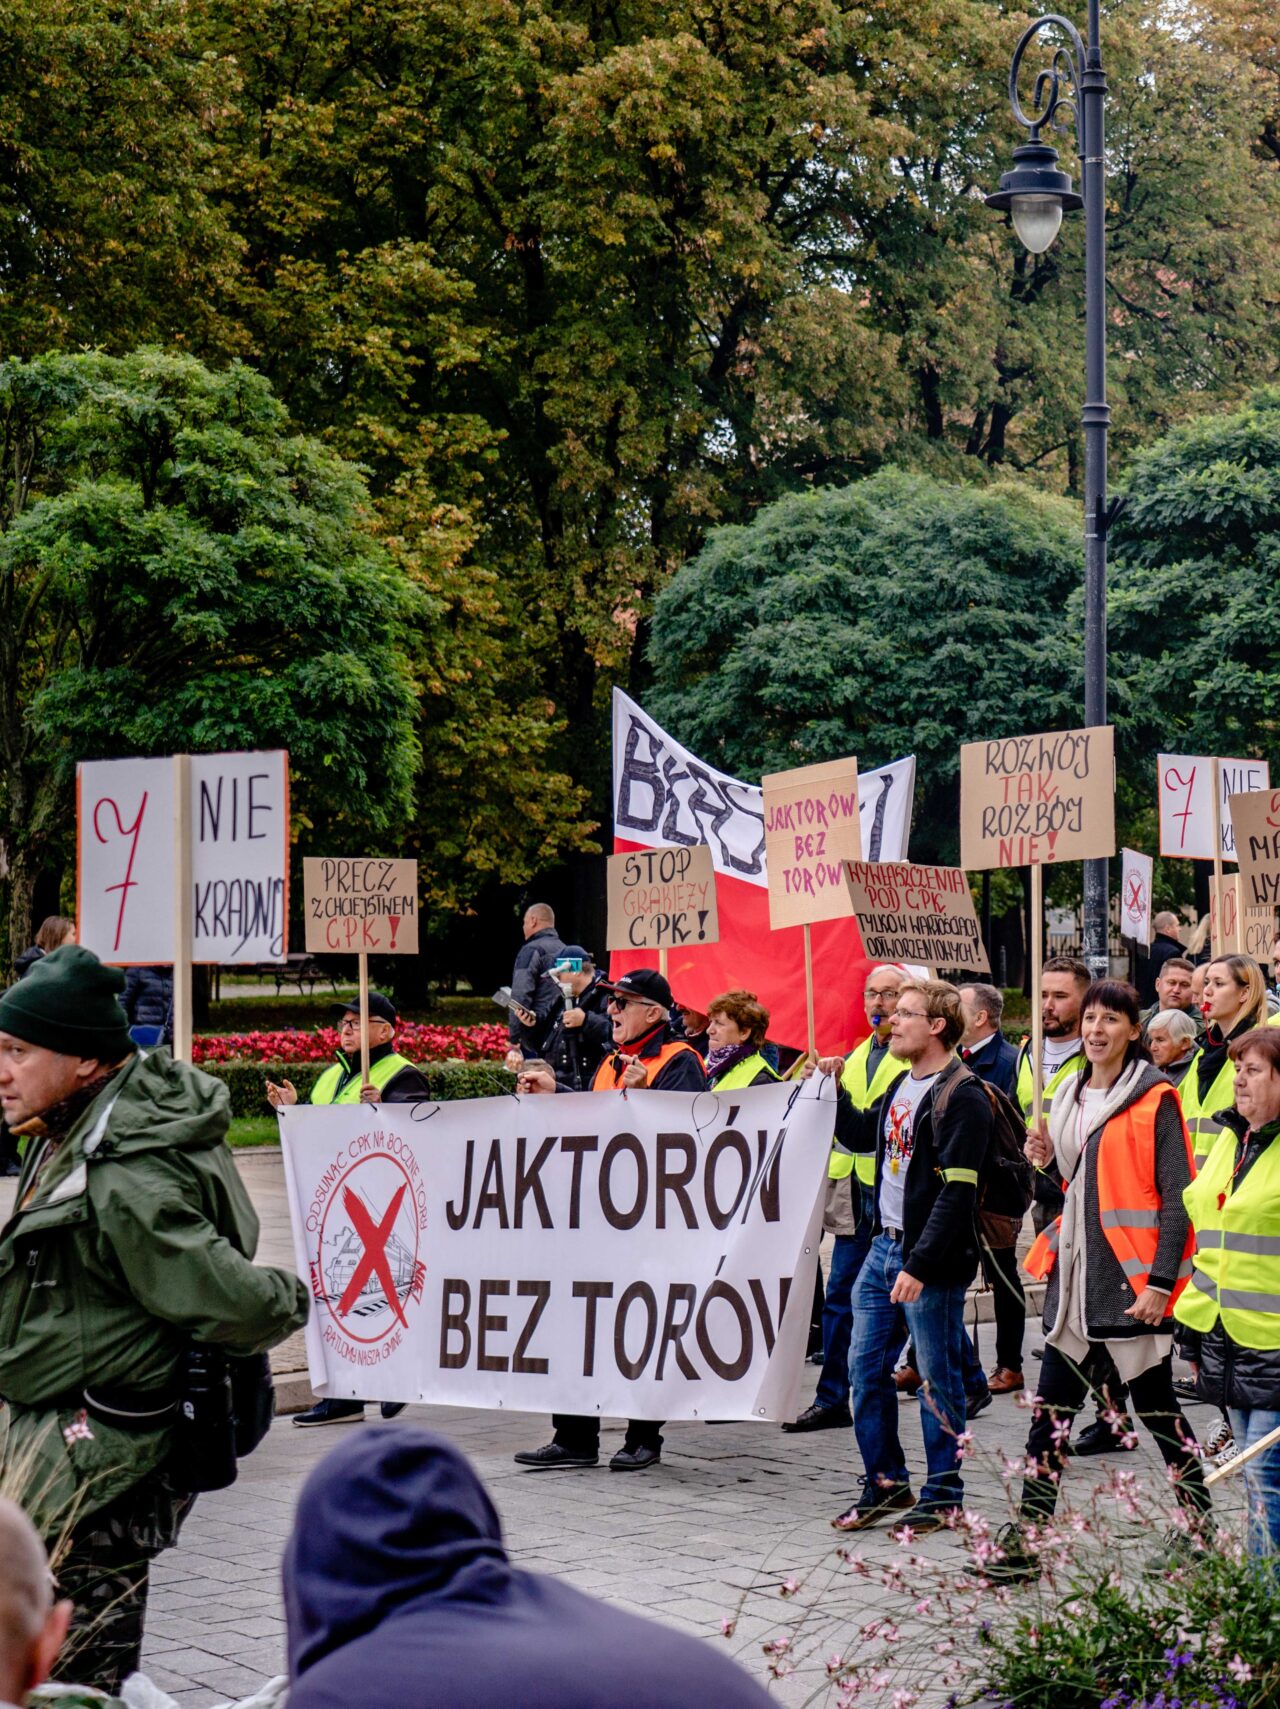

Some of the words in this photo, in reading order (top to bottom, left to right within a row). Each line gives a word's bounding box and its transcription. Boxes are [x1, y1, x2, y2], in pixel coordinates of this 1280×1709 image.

[986, 733, 1090, 779] ROZWÓJ
[999, 772, 1059, 804] TAK
[201, 774, 272, 842] NIE
[766, 789, 856, 832] JAKTORÓW
[982, 795, 1083, 839] ROZBÓJ
[795, 832, 825, 861] BEZ
[999, 831, 1058, 867] NIE!
[321, 859, 397, 893] PRECZ
[623, 848, 691, 886] STOP
[783, 859, 842, 897] TORÓW
[848, 862, 964, 894] WYWŁASZCZENIA
[865, 885, 900, 913] POD
[905, 888, 946, 913] CPK
[326, 916, 401, 949] CPK!
[629, 910, 709, 946] CPK!
[856, 913, 898, 934] TYLKO
[349, 1133, 371, 1158] CPK
[374, 1131, 384, 1148] NA
[387, 1133, 420, 1182] BOCZNE
[416, 1178, 428, 1231] TORY
[445, 1105, 787, 1231] JAKTORÓW
[439, 1279, 551, 1374] BEZ
